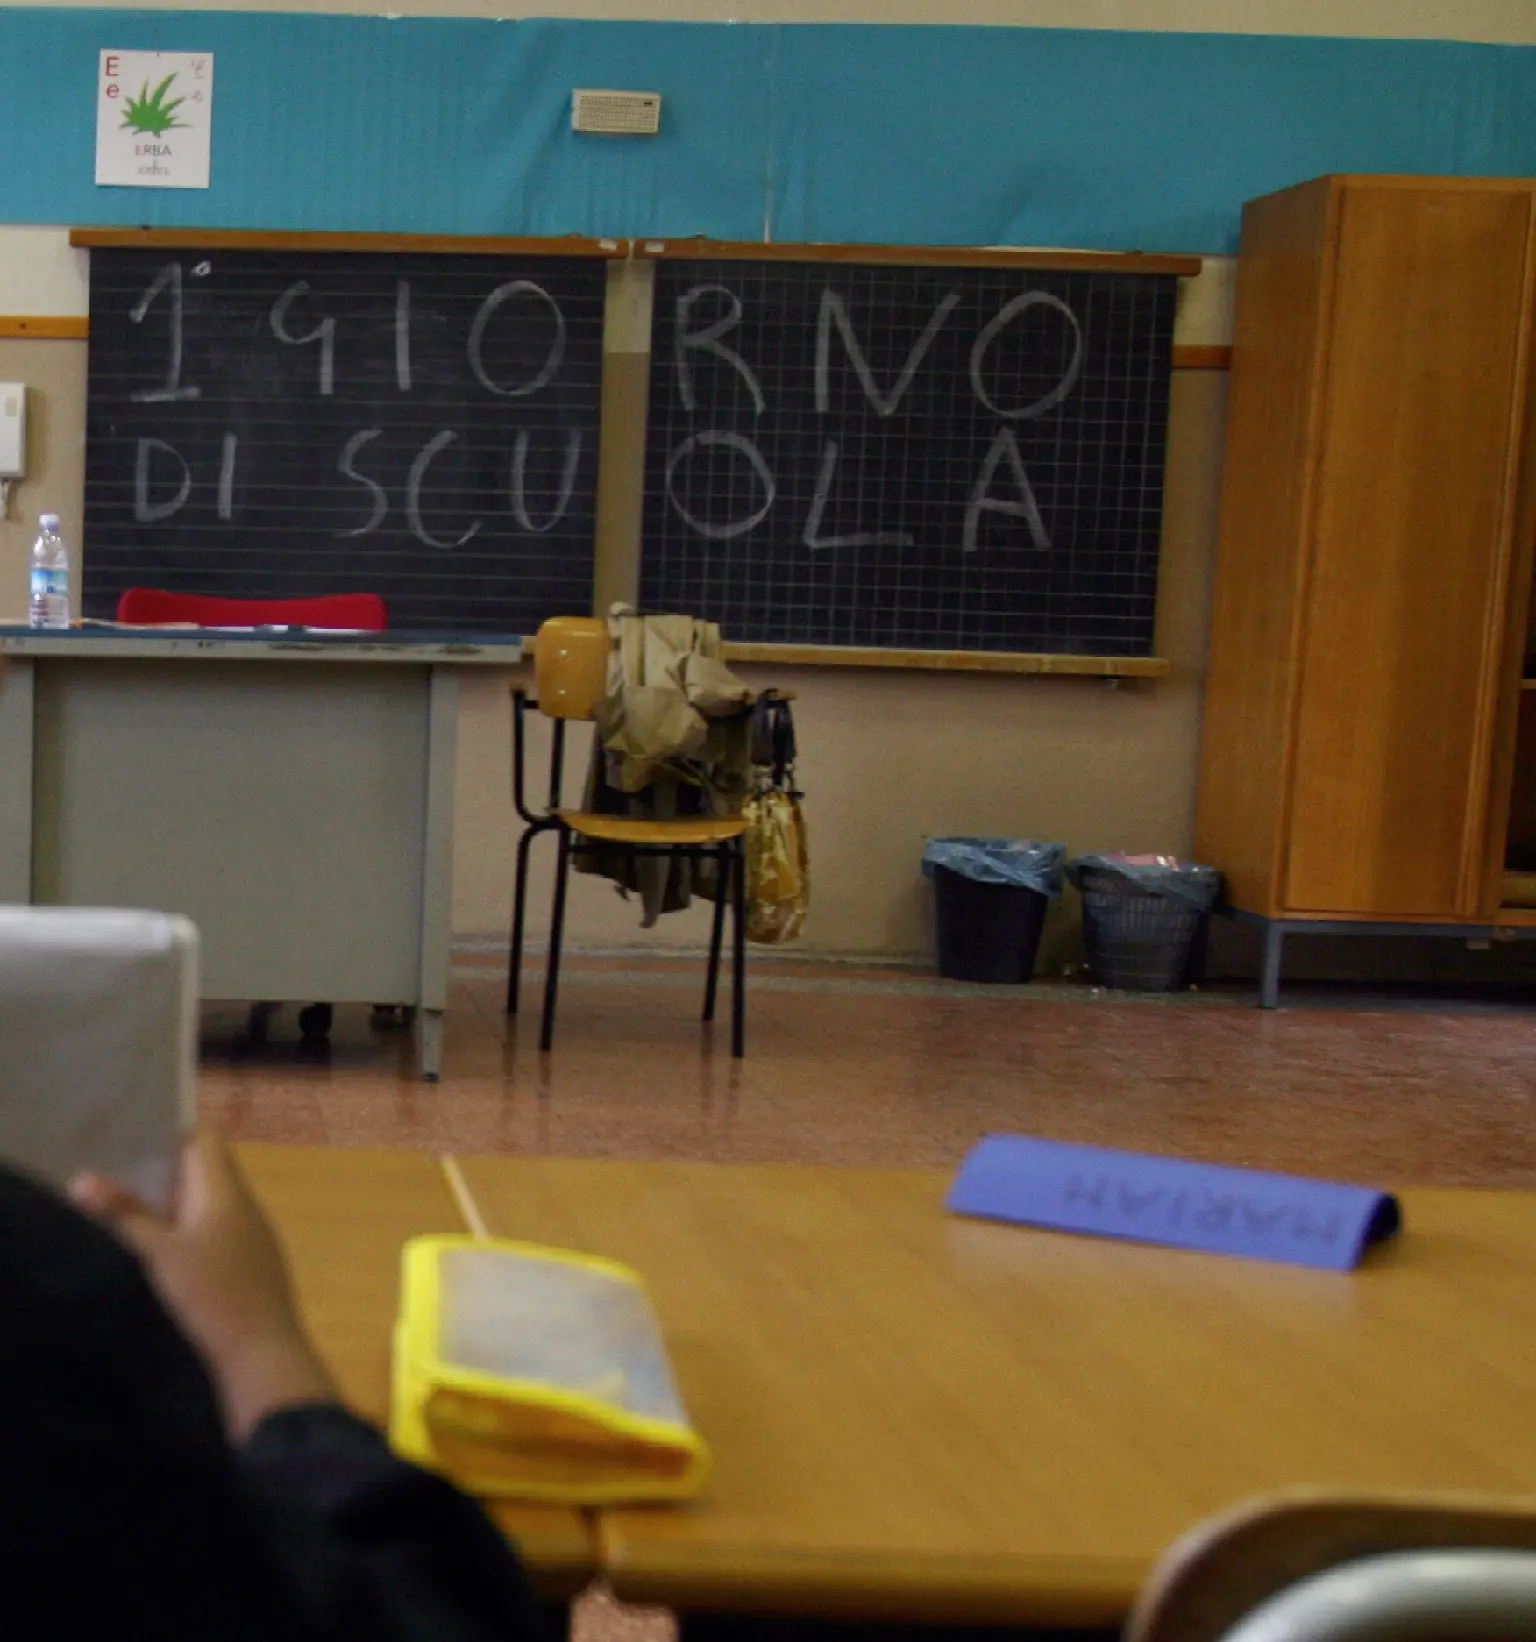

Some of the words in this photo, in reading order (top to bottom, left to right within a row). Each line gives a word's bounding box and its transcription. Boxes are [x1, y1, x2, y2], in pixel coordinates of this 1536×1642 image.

[105, 56, 120, 77] E
[106, 84, 120, 99] e
[135, 144, 172, 157] ERBA
[134, 433, 237, 523] DI
